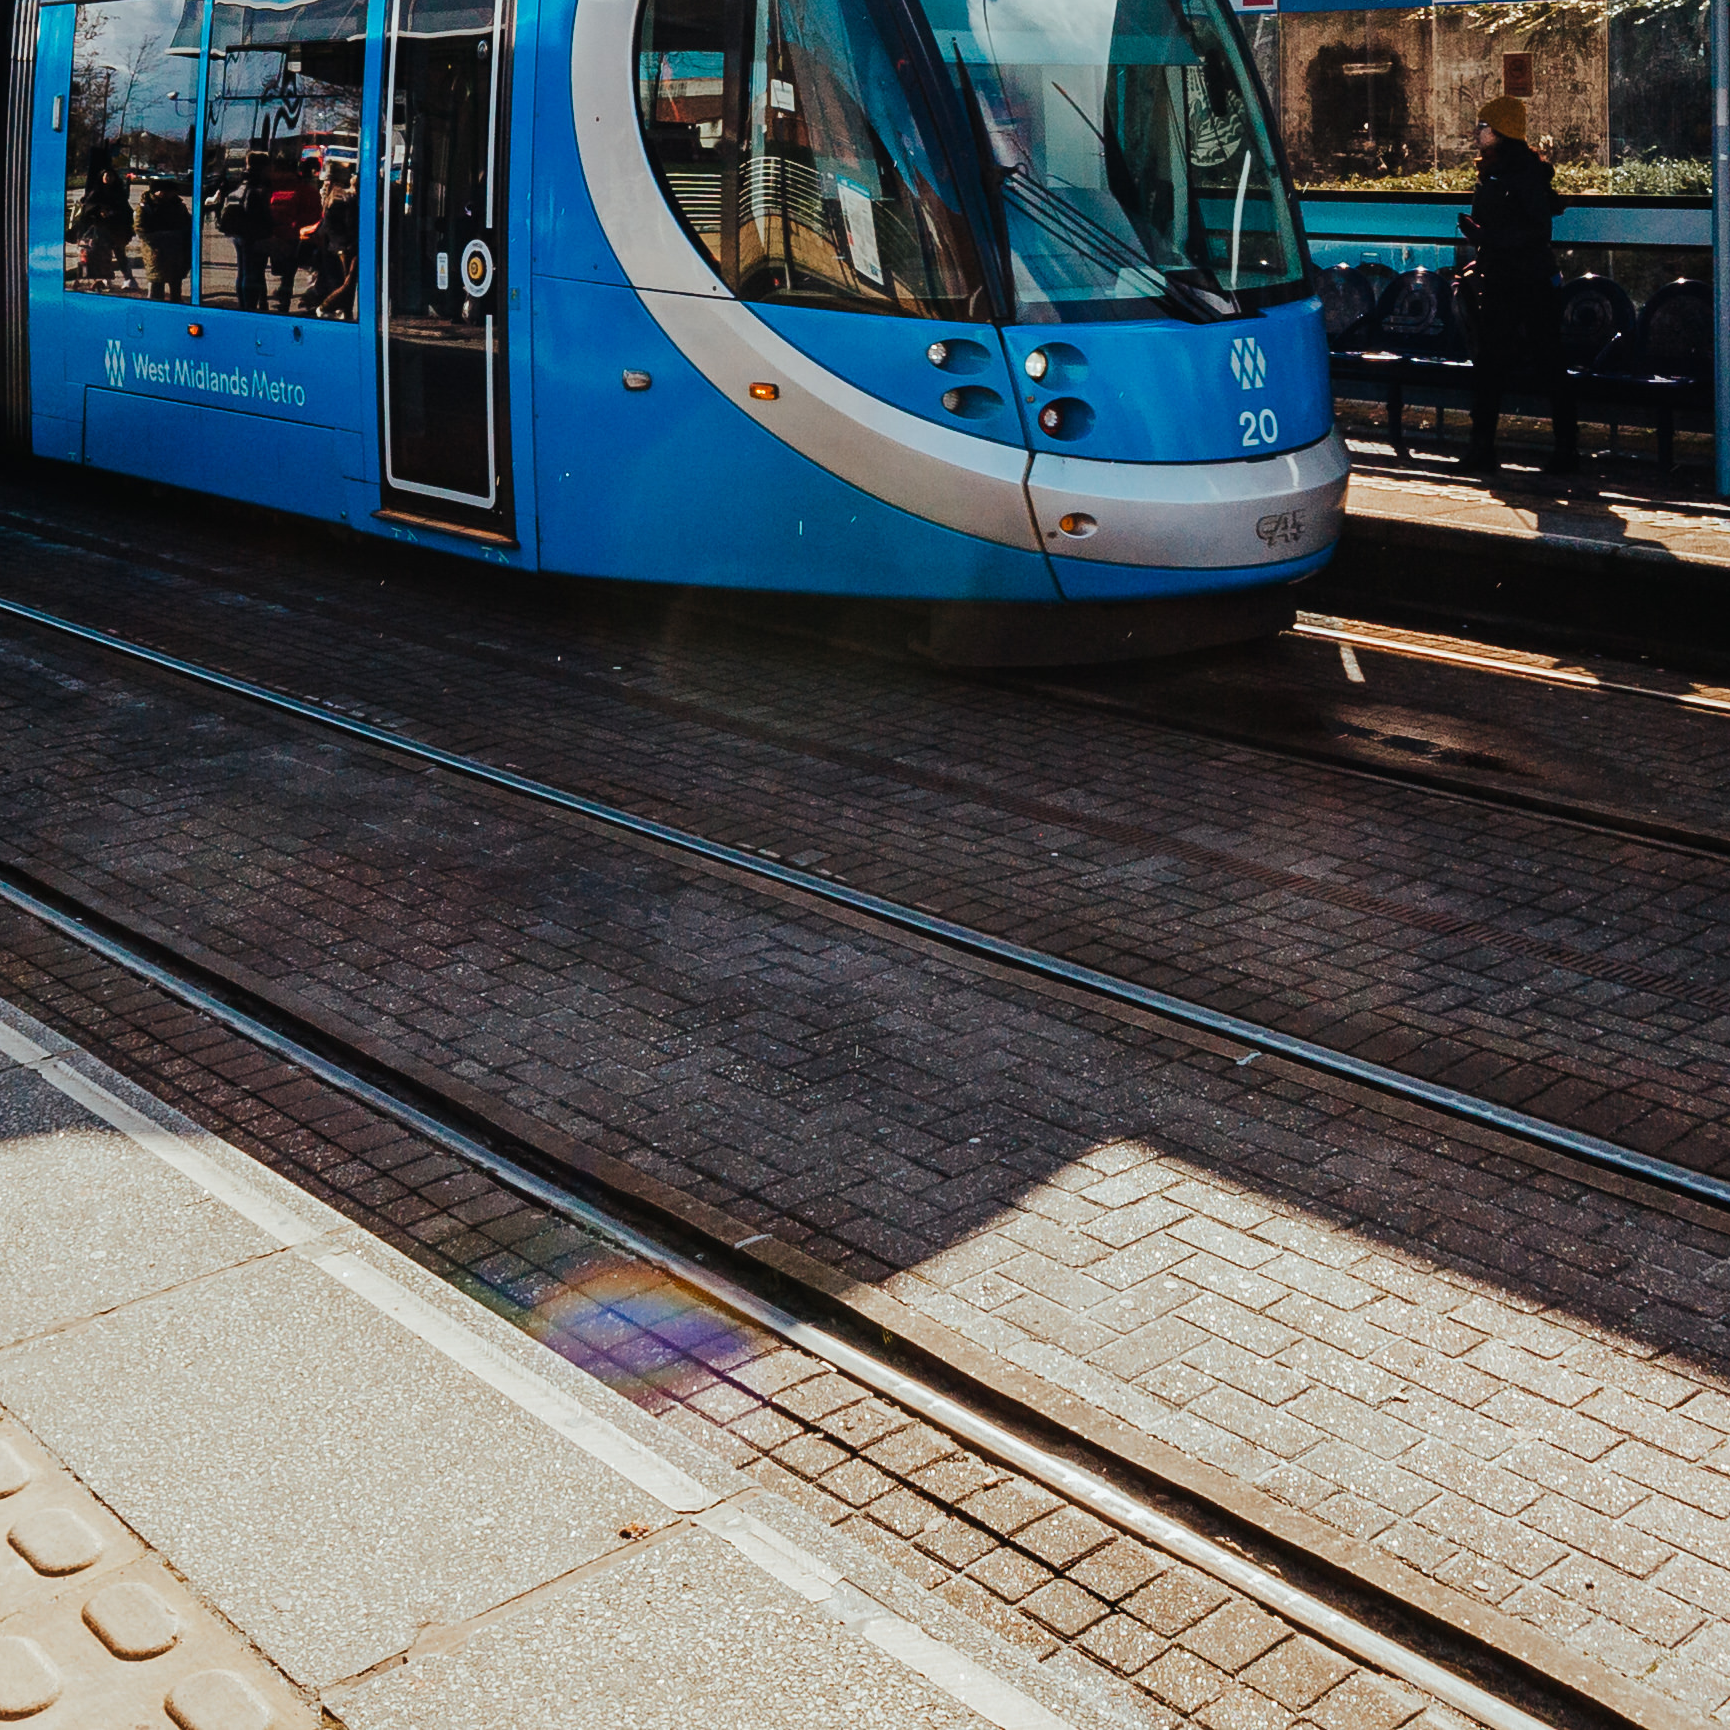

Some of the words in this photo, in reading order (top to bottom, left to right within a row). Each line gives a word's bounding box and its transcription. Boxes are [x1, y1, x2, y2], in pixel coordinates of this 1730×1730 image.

[132, 352, 171, 384] West
[173, 357, 249, 397] Midlands
[251, 369, 306, 407] Metro
[1239, 408, 1279, 447] 20
